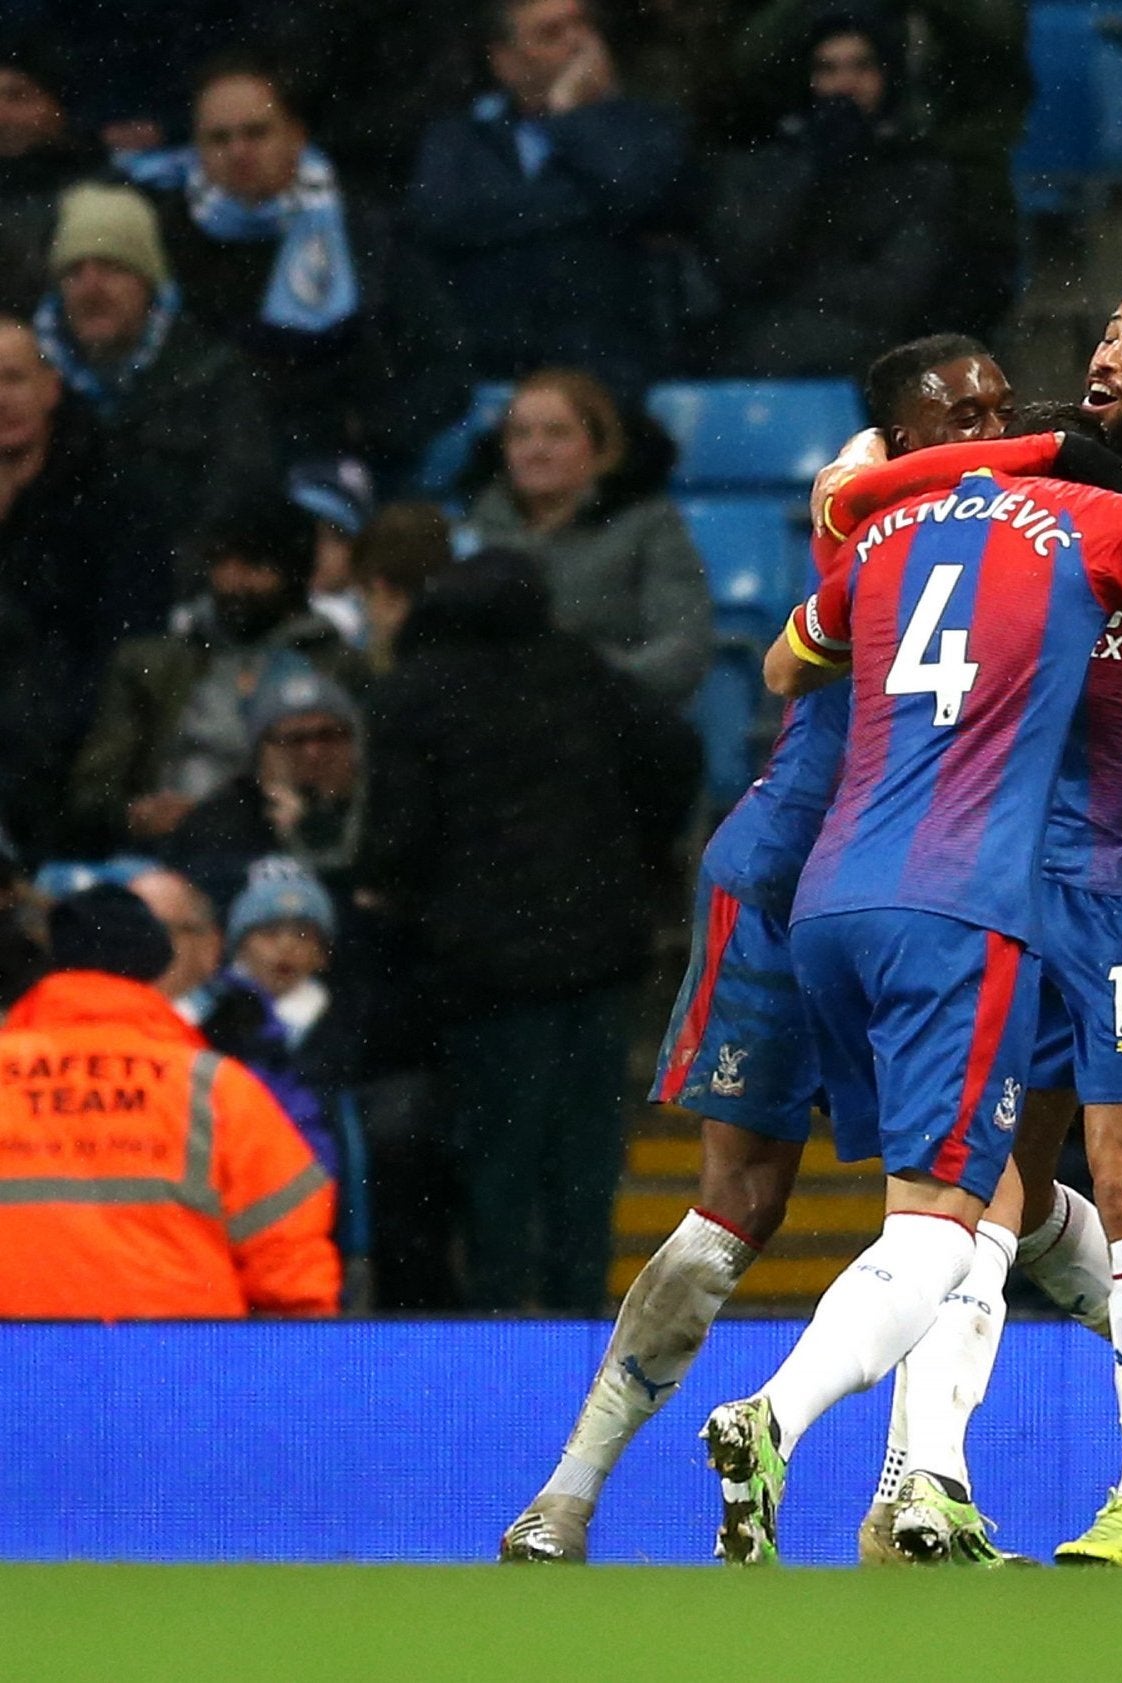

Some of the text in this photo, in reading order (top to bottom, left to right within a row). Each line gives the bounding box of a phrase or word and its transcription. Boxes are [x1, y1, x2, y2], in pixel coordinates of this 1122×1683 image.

[884, 563, 981, 727] 4
[3, 1055, 168, 1079] SAFETY
[24, 1087, 146, 1116] TEAM
